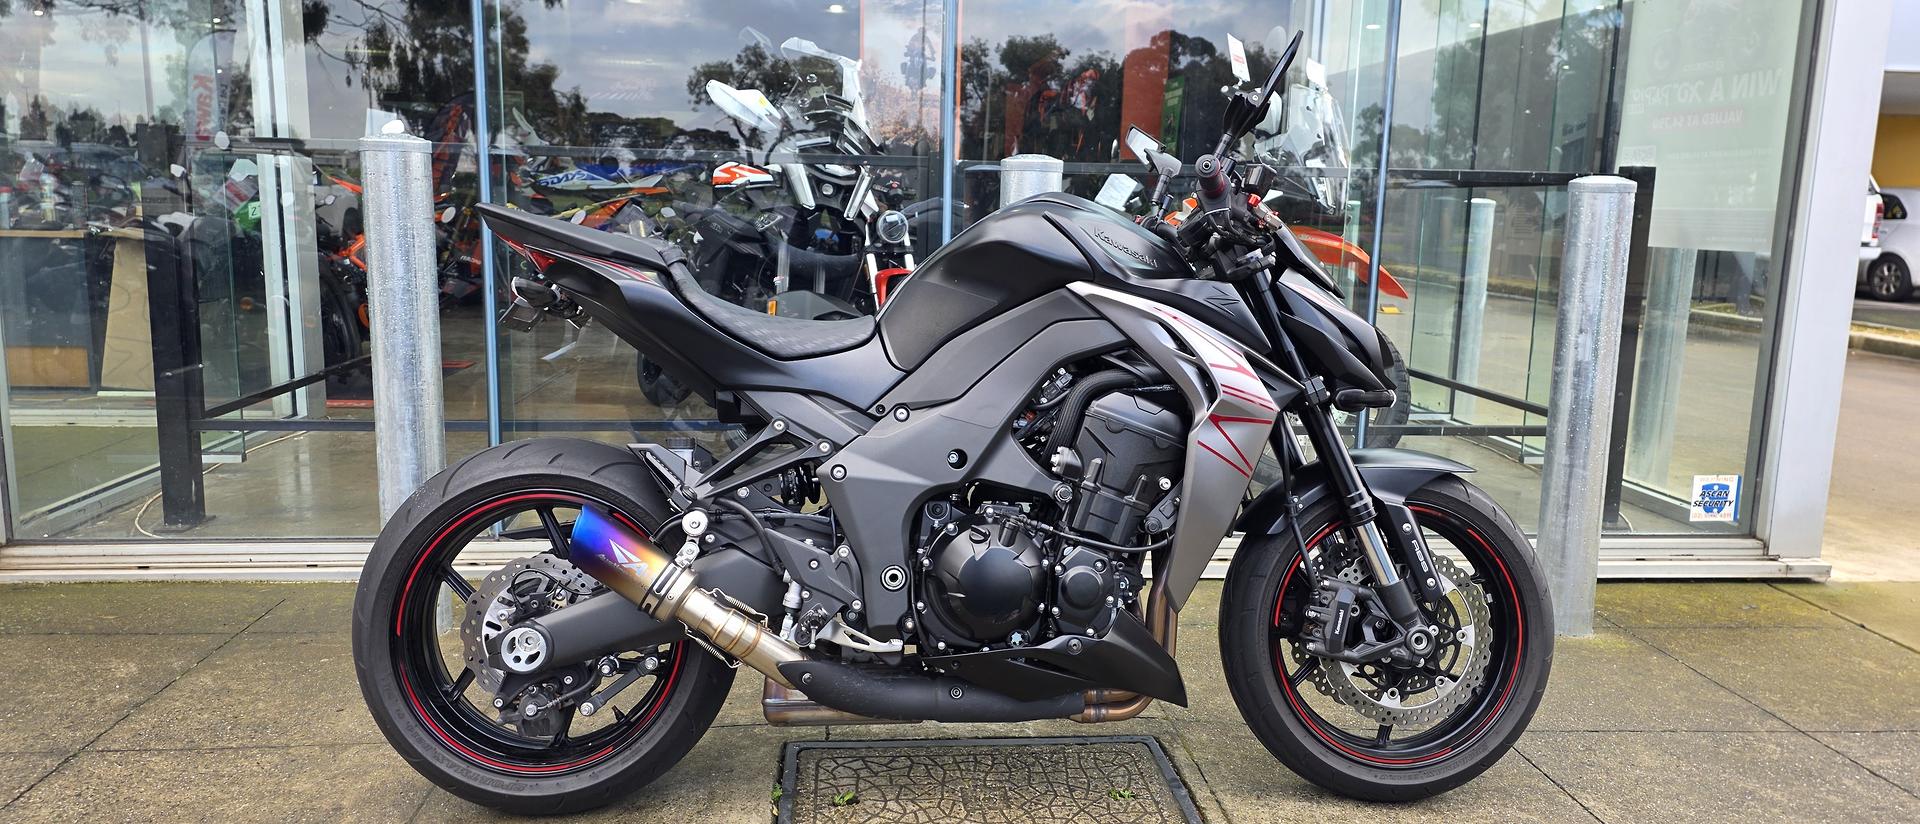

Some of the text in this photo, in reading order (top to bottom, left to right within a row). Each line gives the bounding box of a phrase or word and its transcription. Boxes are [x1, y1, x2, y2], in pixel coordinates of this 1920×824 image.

[1094, 228, 1158, 268] Kawasaki
[1699, 490, 1730, 498] ASCAN
[1411, 540, 1429, 573] ABS
[1335, 609, 1345, 635] Kawasaki
